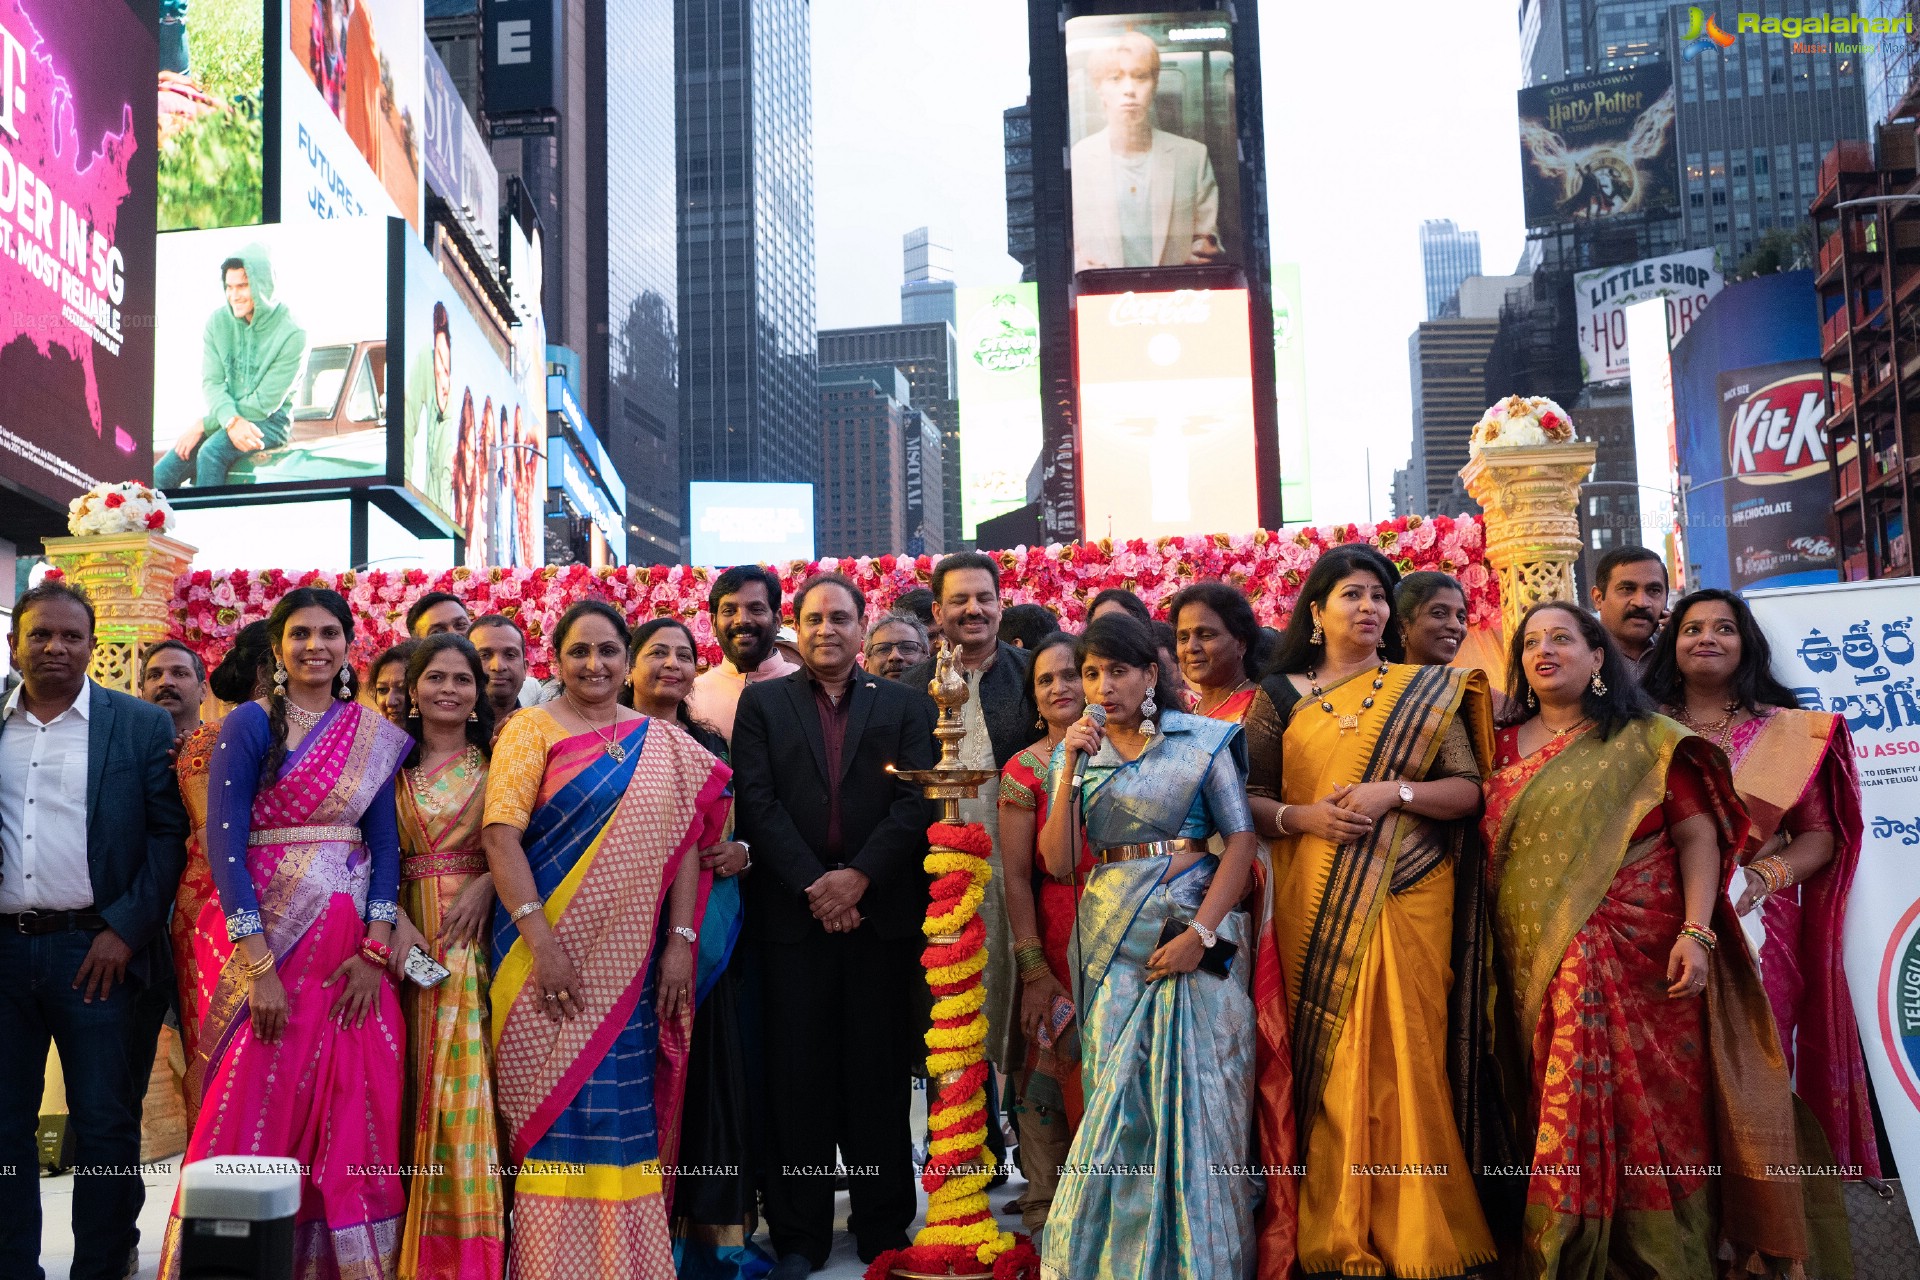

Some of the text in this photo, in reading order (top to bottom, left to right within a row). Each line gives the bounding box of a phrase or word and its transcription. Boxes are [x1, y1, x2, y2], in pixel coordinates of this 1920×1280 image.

[1572, 73, 1636, 91] BROADWAY
[1547, 90, 1643, 130] Harry Potter
[298, 121, 353, 217] FUTURE
[17, 232, 61, 293] MOST
[59, 199, 88, 277] IN
[91, 230, 125, 306] 5G
[1590, 263, 1710, 309] LITTLE SHOP
[1744, 501, 1793, 520] CHOCOLATE
[1877, 766, 1916, 776] IDENTIFY
[1884, 775, 1918, 785] TELUGU
